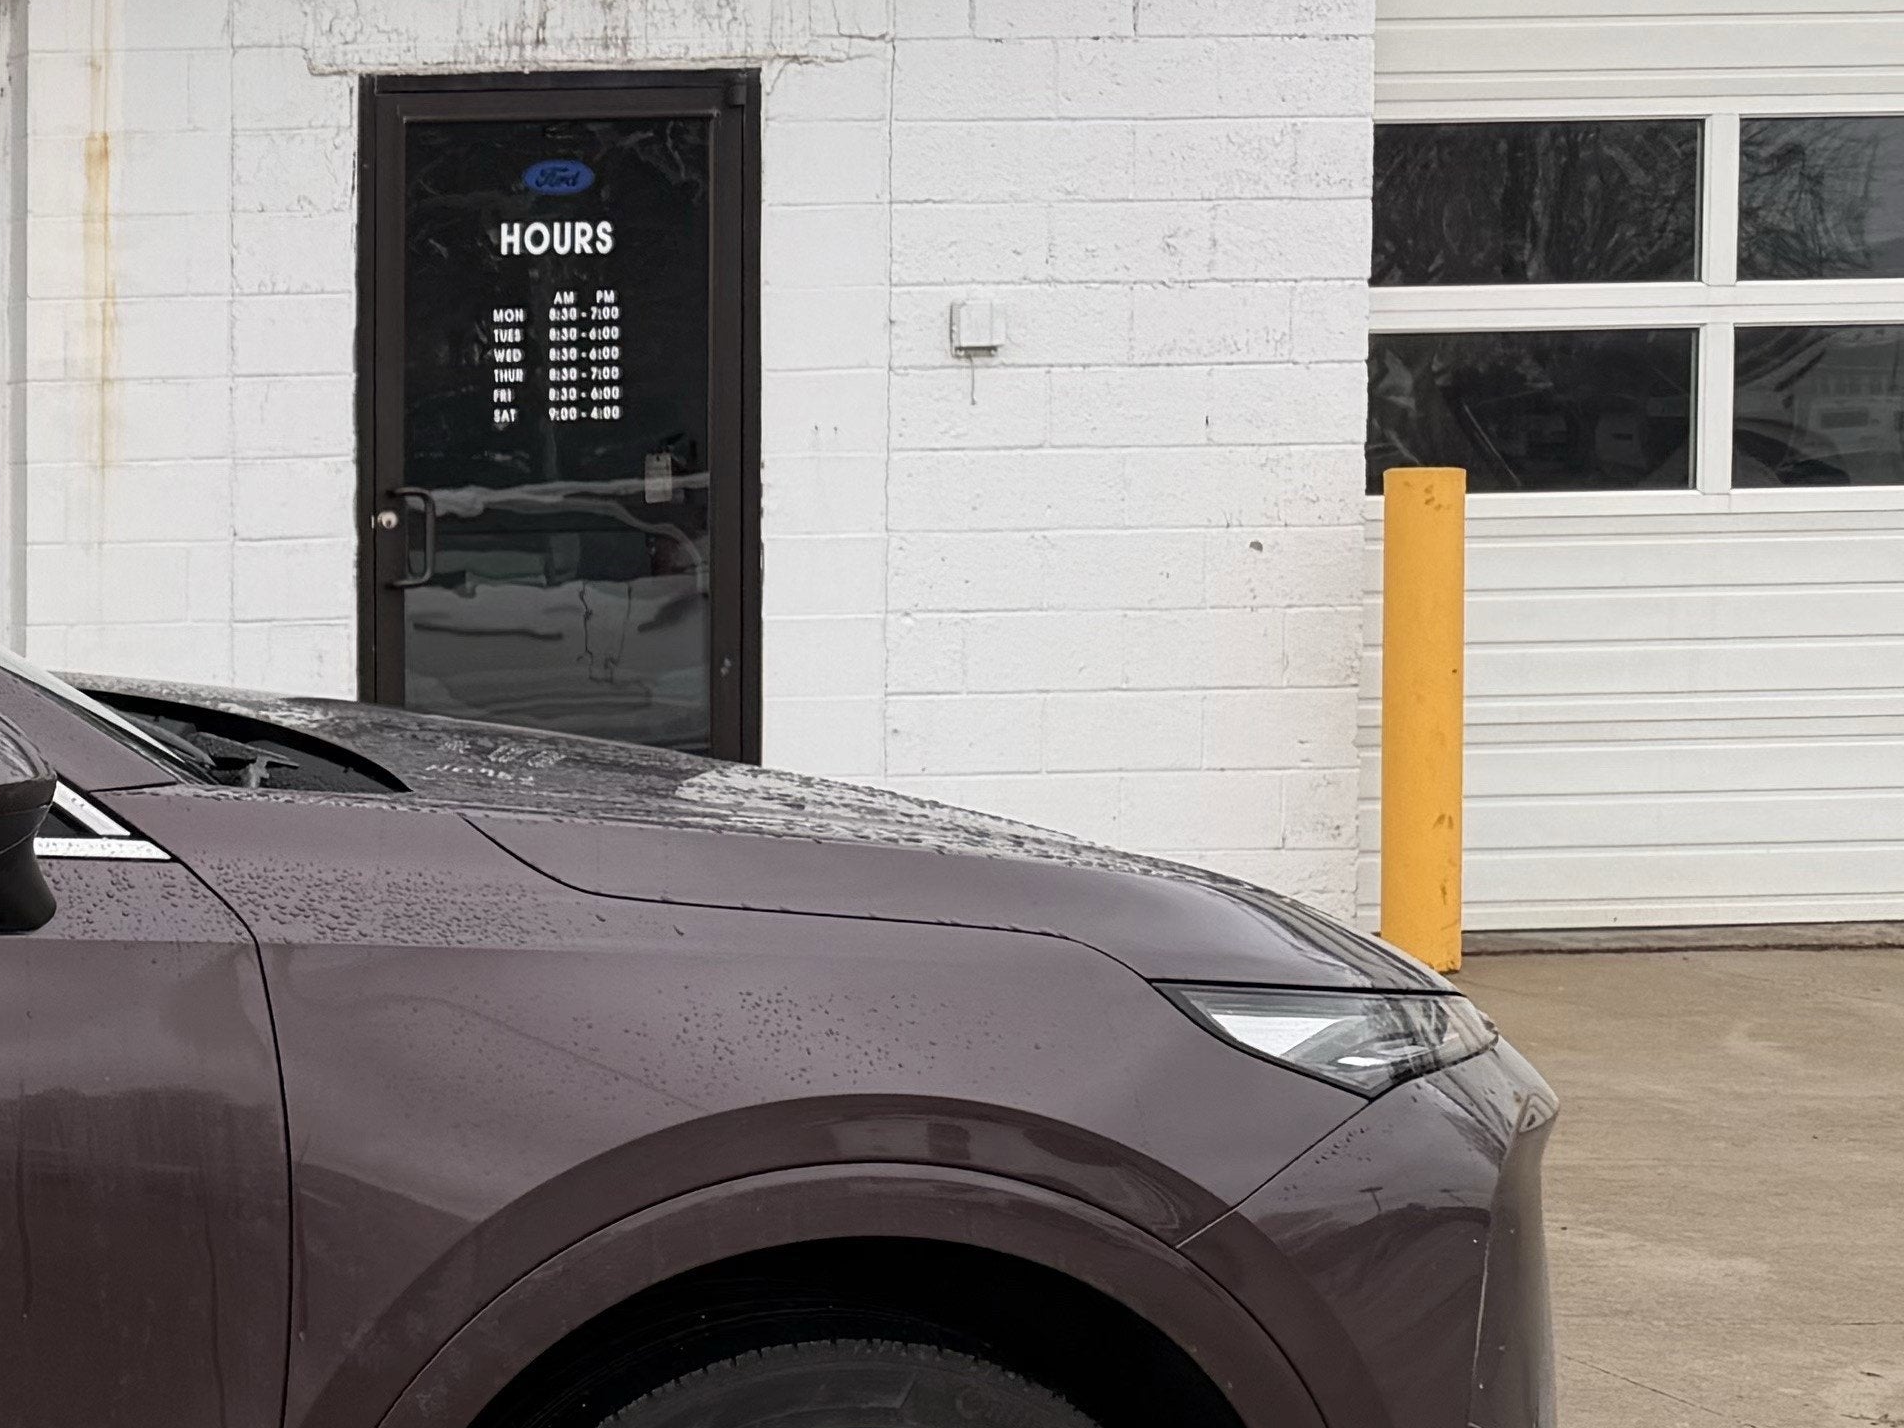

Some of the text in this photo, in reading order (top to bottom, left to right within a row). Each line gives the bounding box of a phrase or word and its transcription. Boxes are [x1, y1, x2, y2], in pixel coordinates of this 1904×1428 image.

[533, 166, 580, 187] Ford
[500, 220, 613, 256] HOURS
[553, 289, 615, 305] AM PM
[492, 308, 525, 323] MON
[493, 328, 521, 343] TUES
[493, 348, 523, 363] WED
[493, 368, 524, 383] THUR
[493, 388, 512, 403] FRI
[493, 408, 517, 423] SAT
